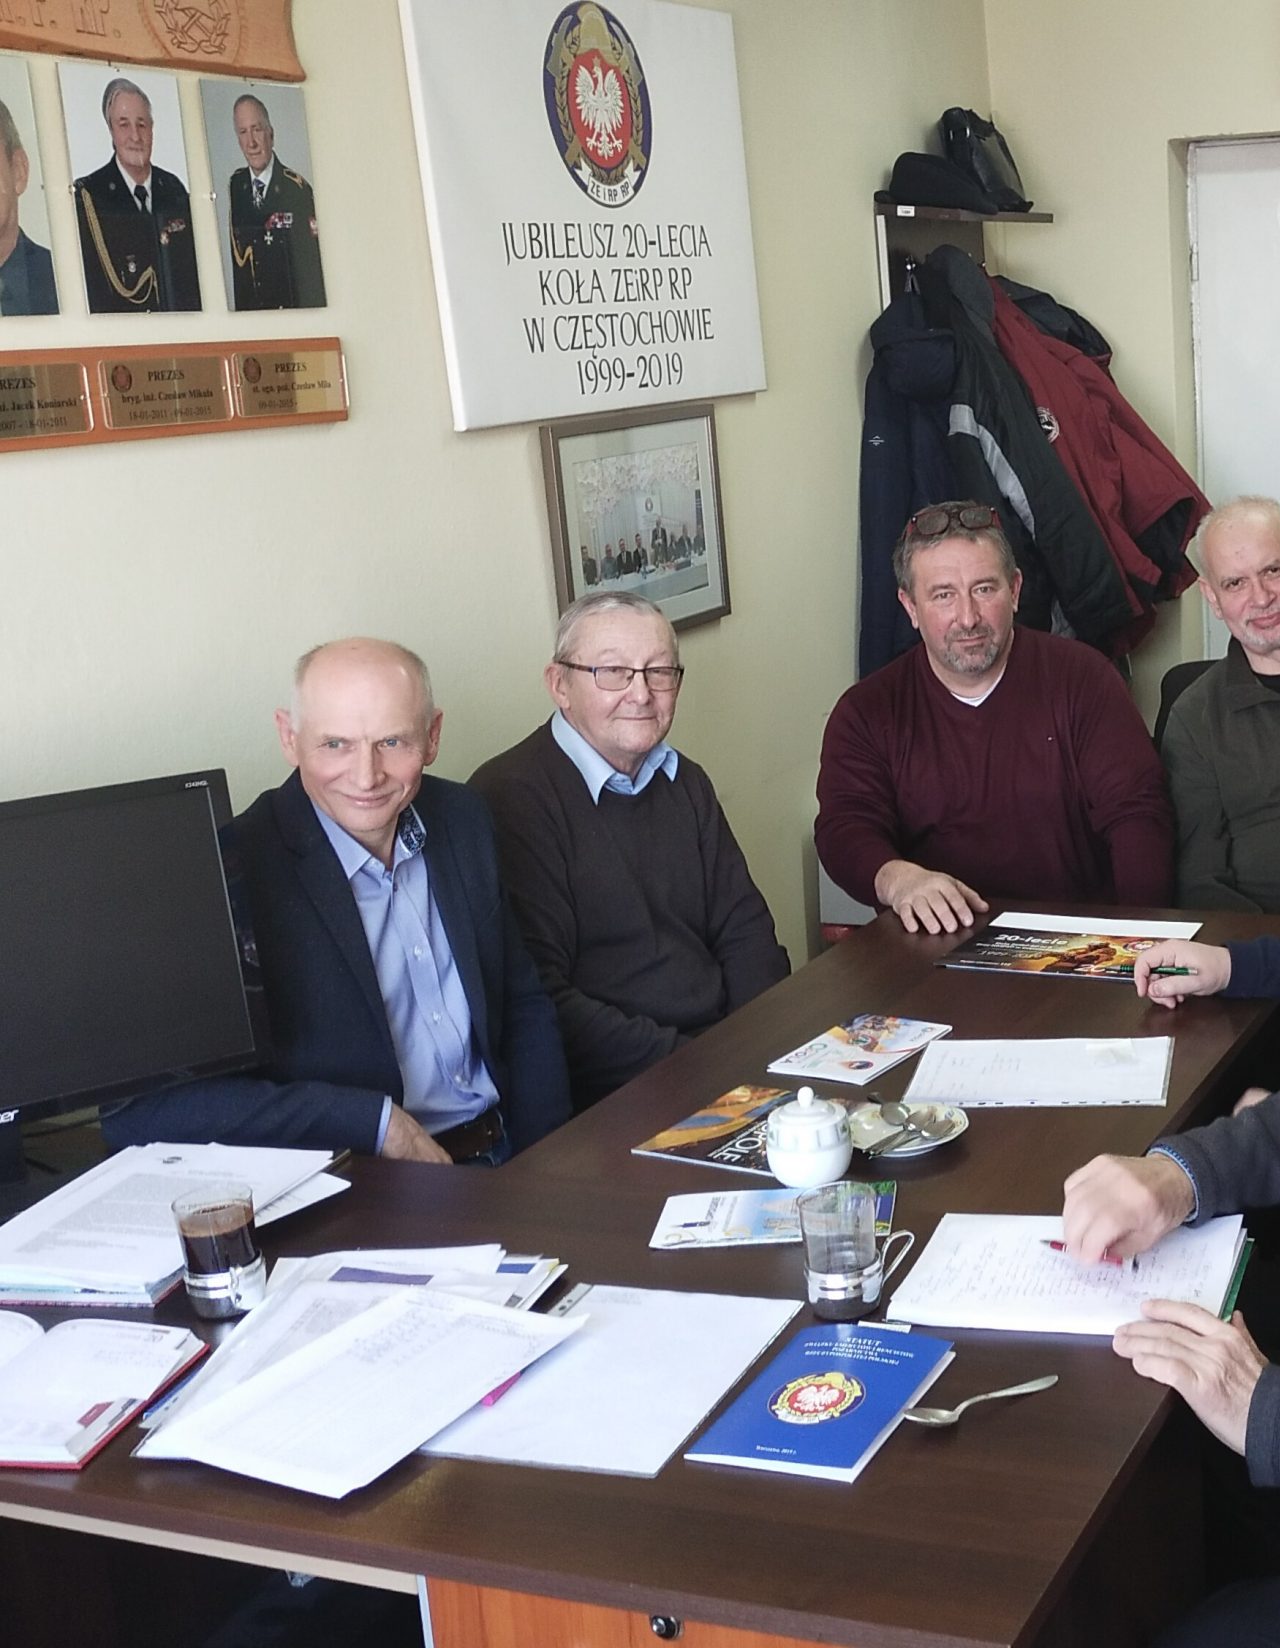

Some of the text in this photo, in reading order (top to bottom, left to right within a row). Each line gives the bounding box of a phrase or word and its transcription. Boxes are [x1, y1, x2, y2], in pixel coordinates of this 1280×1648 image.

[502, 222, 712, 266] JUBILEUSZ 20-LECIA
[539, 269, 606, 306] KOŁA
[668, 267, 692, 300] RP
[523, 308, 714, 359] W CZĘSTOCHOWIE
[148, 370, 185, 381] PREZES
[274, 362, 307, 373] PREZES
[577, 352, 683, 395] 1999-2019
